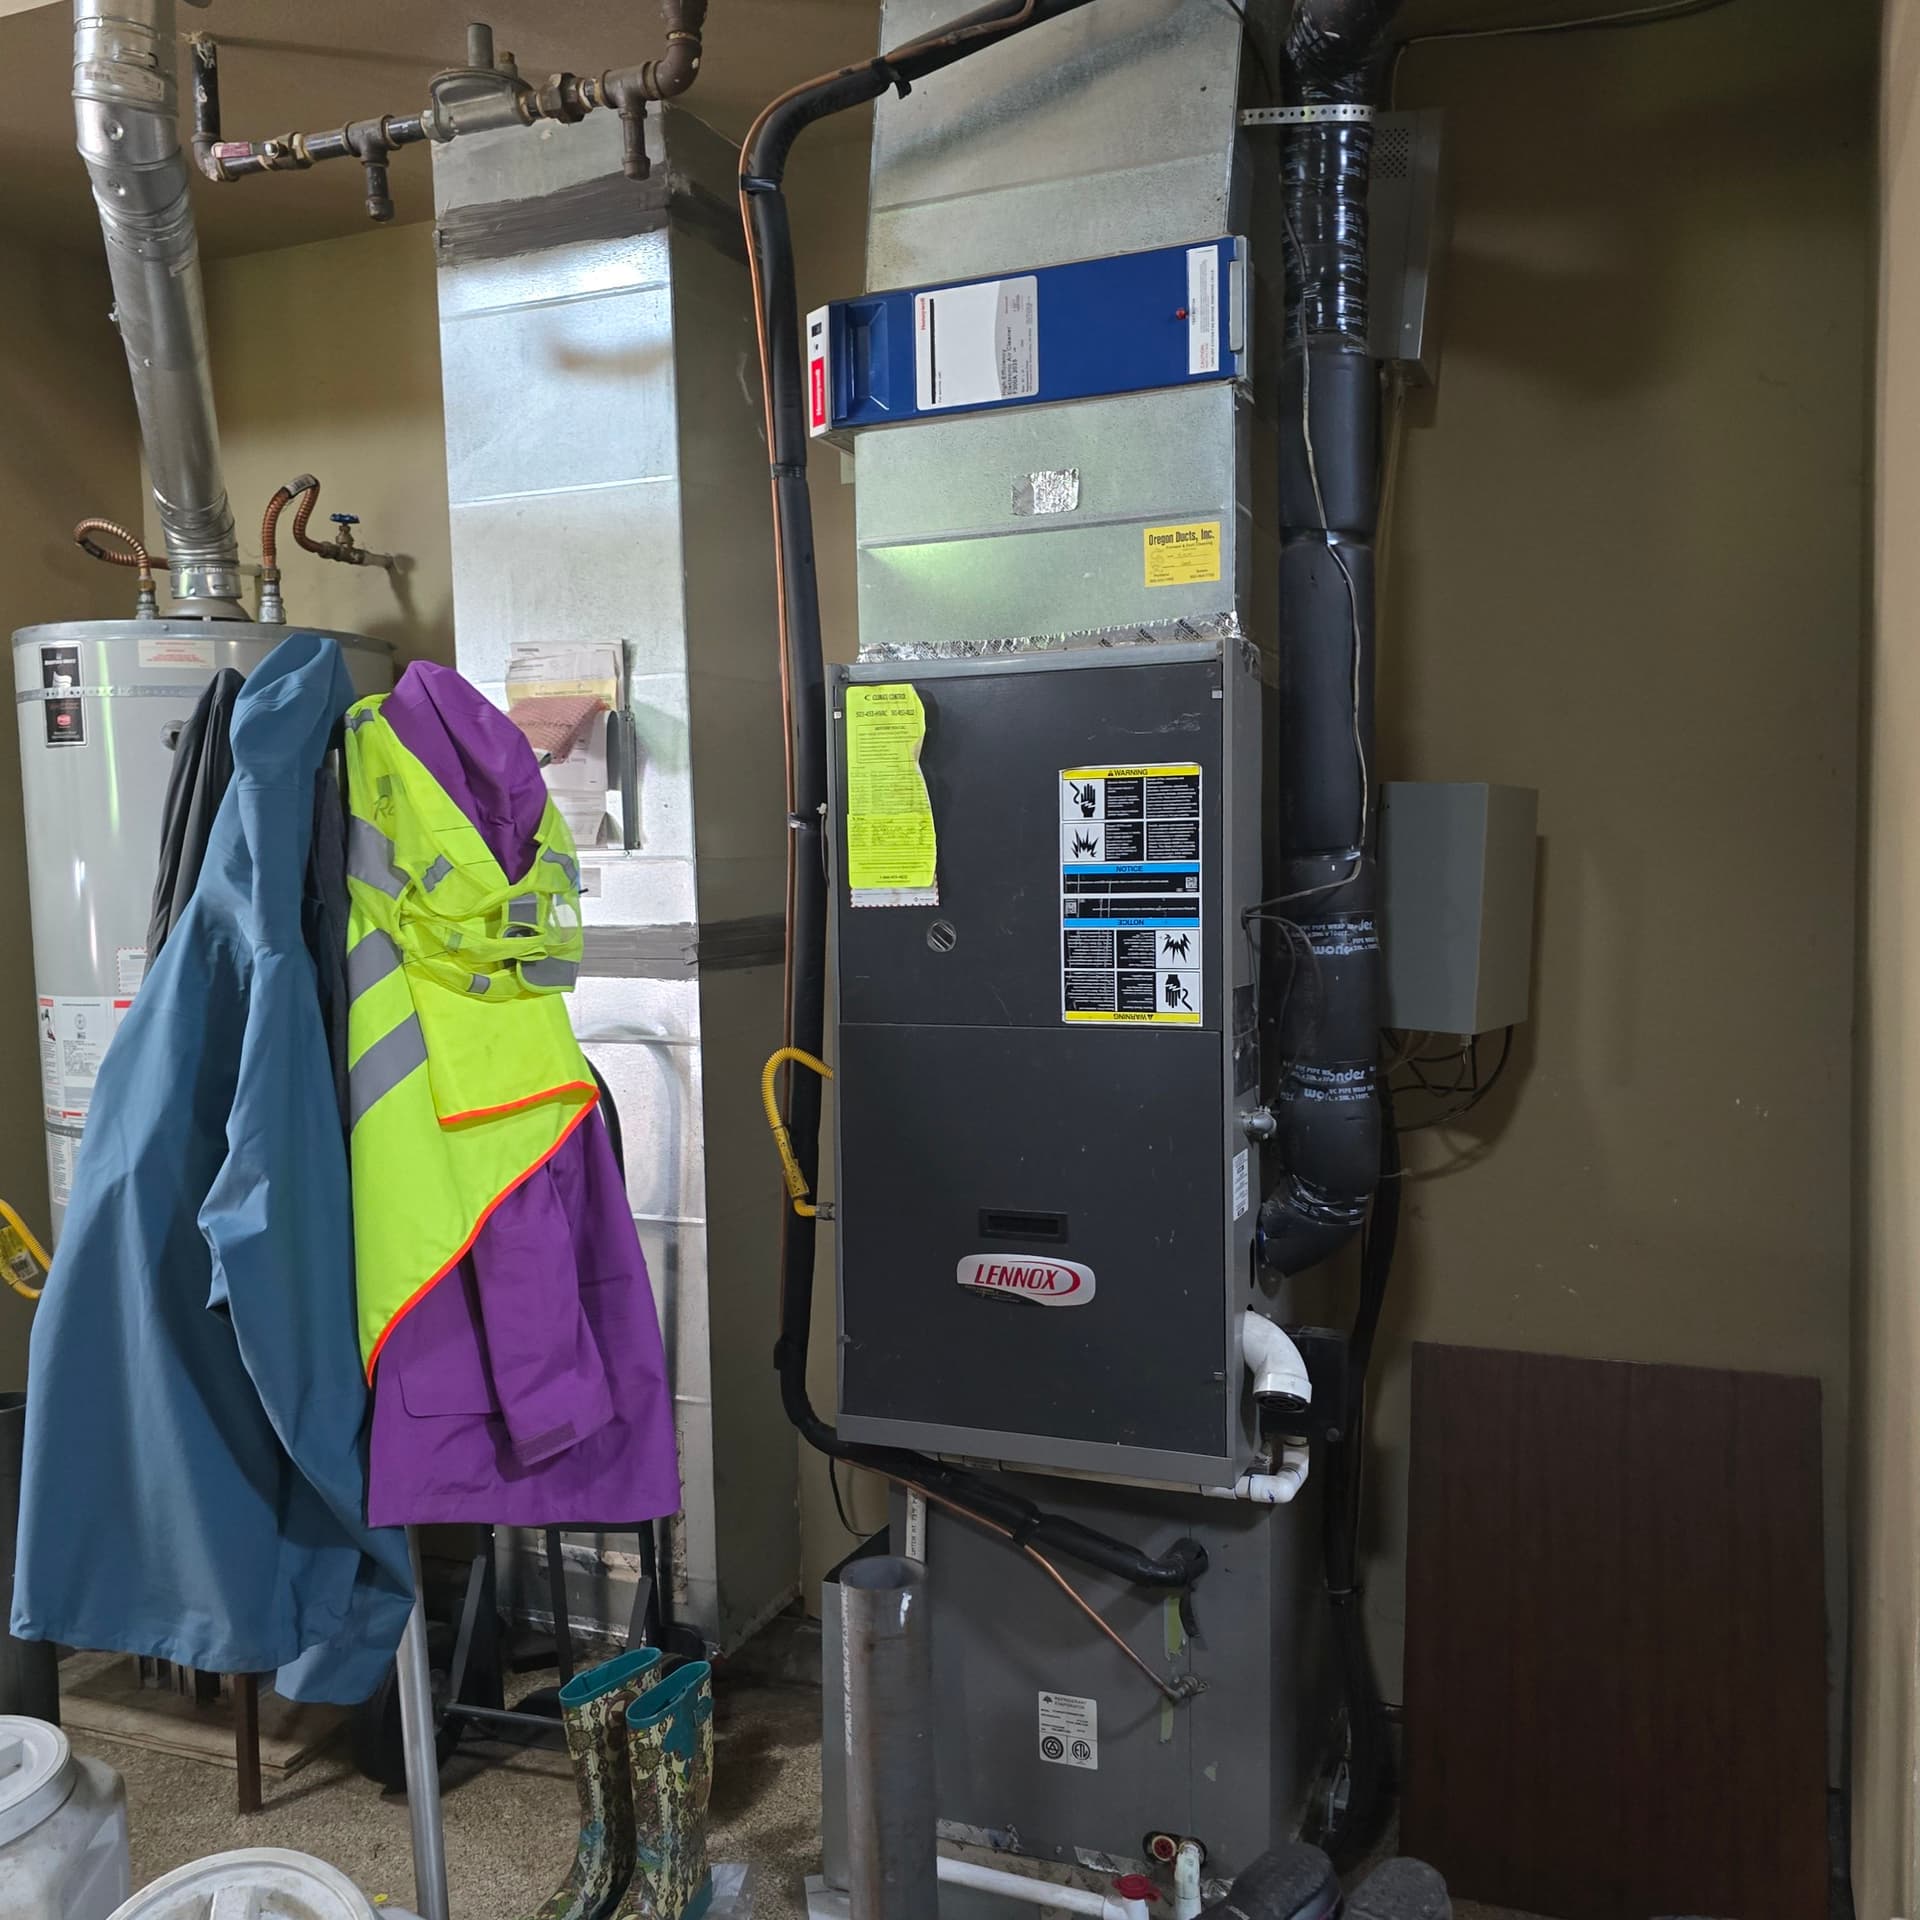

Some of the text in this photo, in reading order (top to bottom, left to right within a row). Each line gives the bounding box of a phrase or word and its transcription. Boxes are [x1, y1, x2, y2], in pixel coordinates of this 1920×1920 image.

[1149, 528, 1215, 546] Oregon Ducts, Inc.
[974, 1264, 1060, 1290] LENNOX
